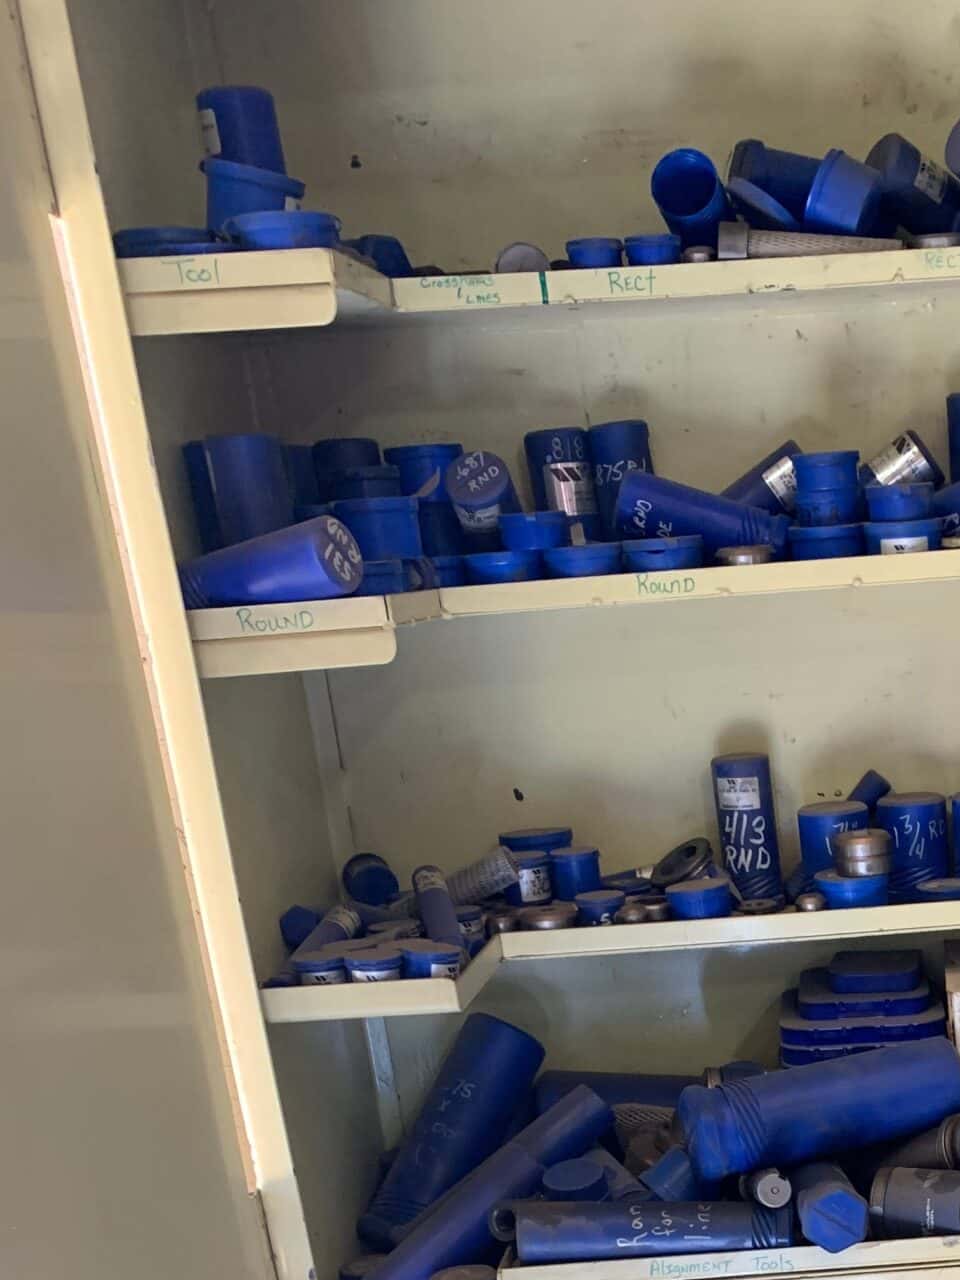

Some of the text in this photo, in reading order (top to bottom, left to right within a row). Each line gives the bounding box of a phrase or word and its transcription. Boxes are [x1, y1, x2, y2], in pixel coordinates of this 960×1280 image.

[160, 258, 221, 284] Tool
[467, 466, 500, 492] RND
[725, 844, 771, 875] RND
